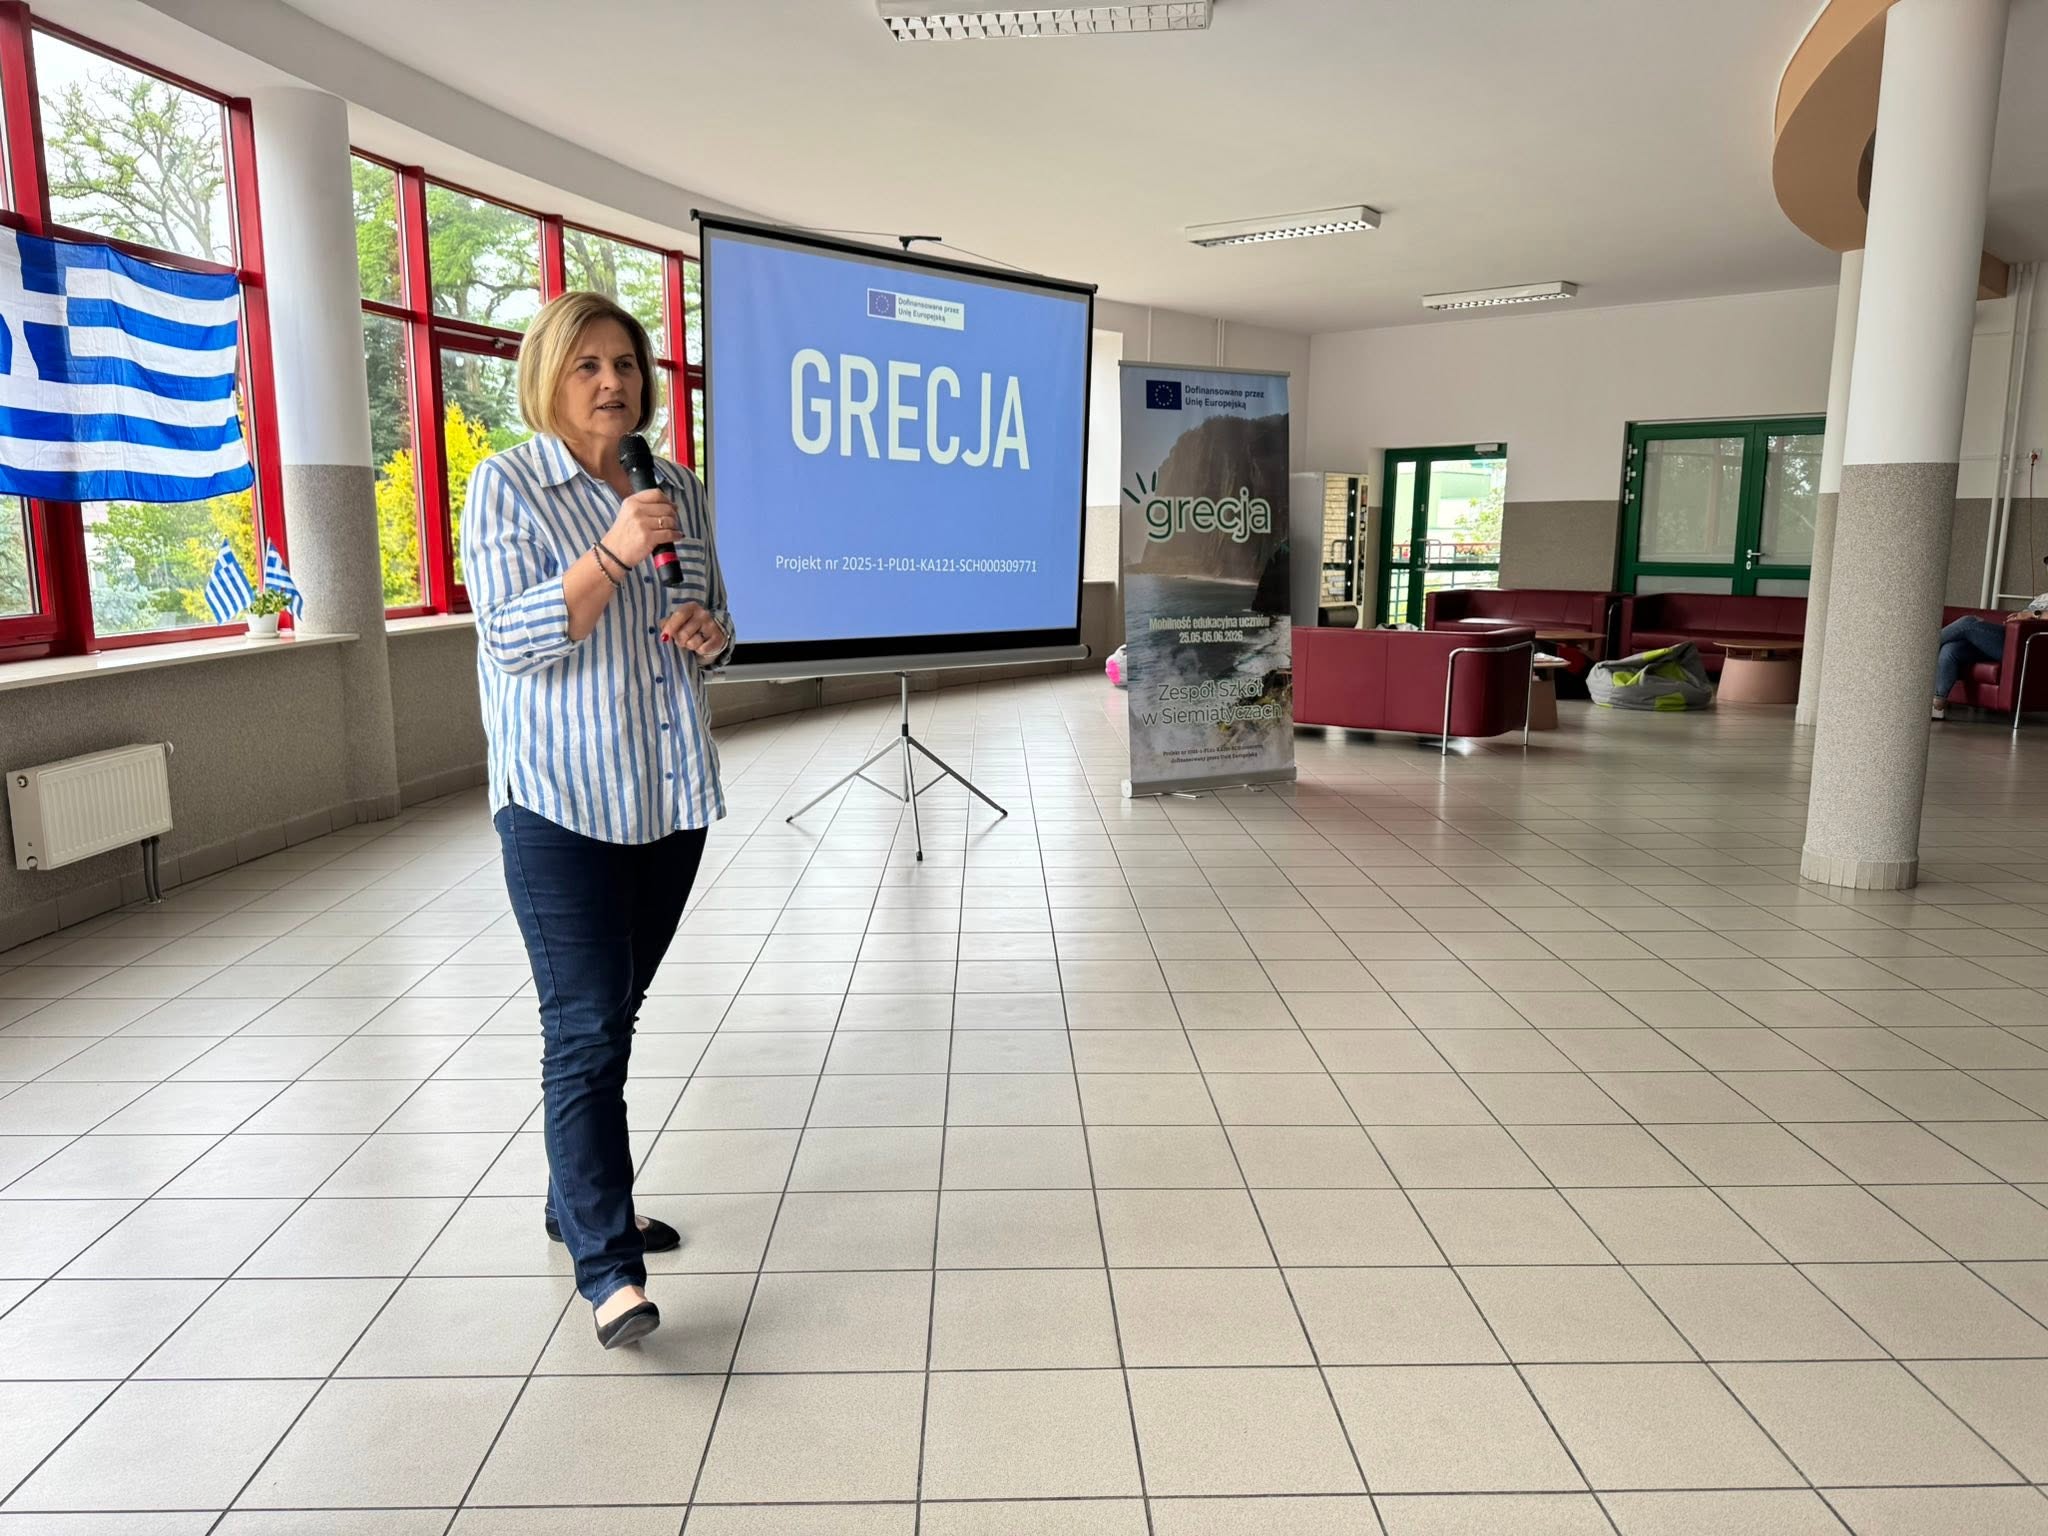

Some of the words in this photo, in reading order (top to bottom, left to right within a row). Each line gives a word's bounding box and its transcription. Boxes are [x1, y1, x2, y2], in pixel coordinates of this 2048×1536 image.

[898, 297, 943, 311] Dofinansowane
[943, 306, 960, 315] przez
[1185, 385, 1243, 397] Dofinansowane
[1244, 390, 1264, 399] przez
[790, 348, 1030, 470] GRECJA
[1185, 397, 1203, 408] Unię
[1204, 399, 1247, 410] Europejską
[1145, 487, 1272, 543] grecja
[775, 555, 822, 573] Projekt
[825, 559, 839, 570] nr
[842, 556, 1038, 573] 2025-1-PL01-KA121-SCH000309771
[1149, 616, 1192, 631] Mobilność
[1192, 615, 1238, 630] edukacyjna
[1238, 614, 1271, 628] uczniów
[1158, 680, 1215, 703] Zespół
[1218, 678, 1264, 698] Szkół
[1142, 711, 1158, 726] w
[1161, 700, 1282, 726] Siemiatyczach
